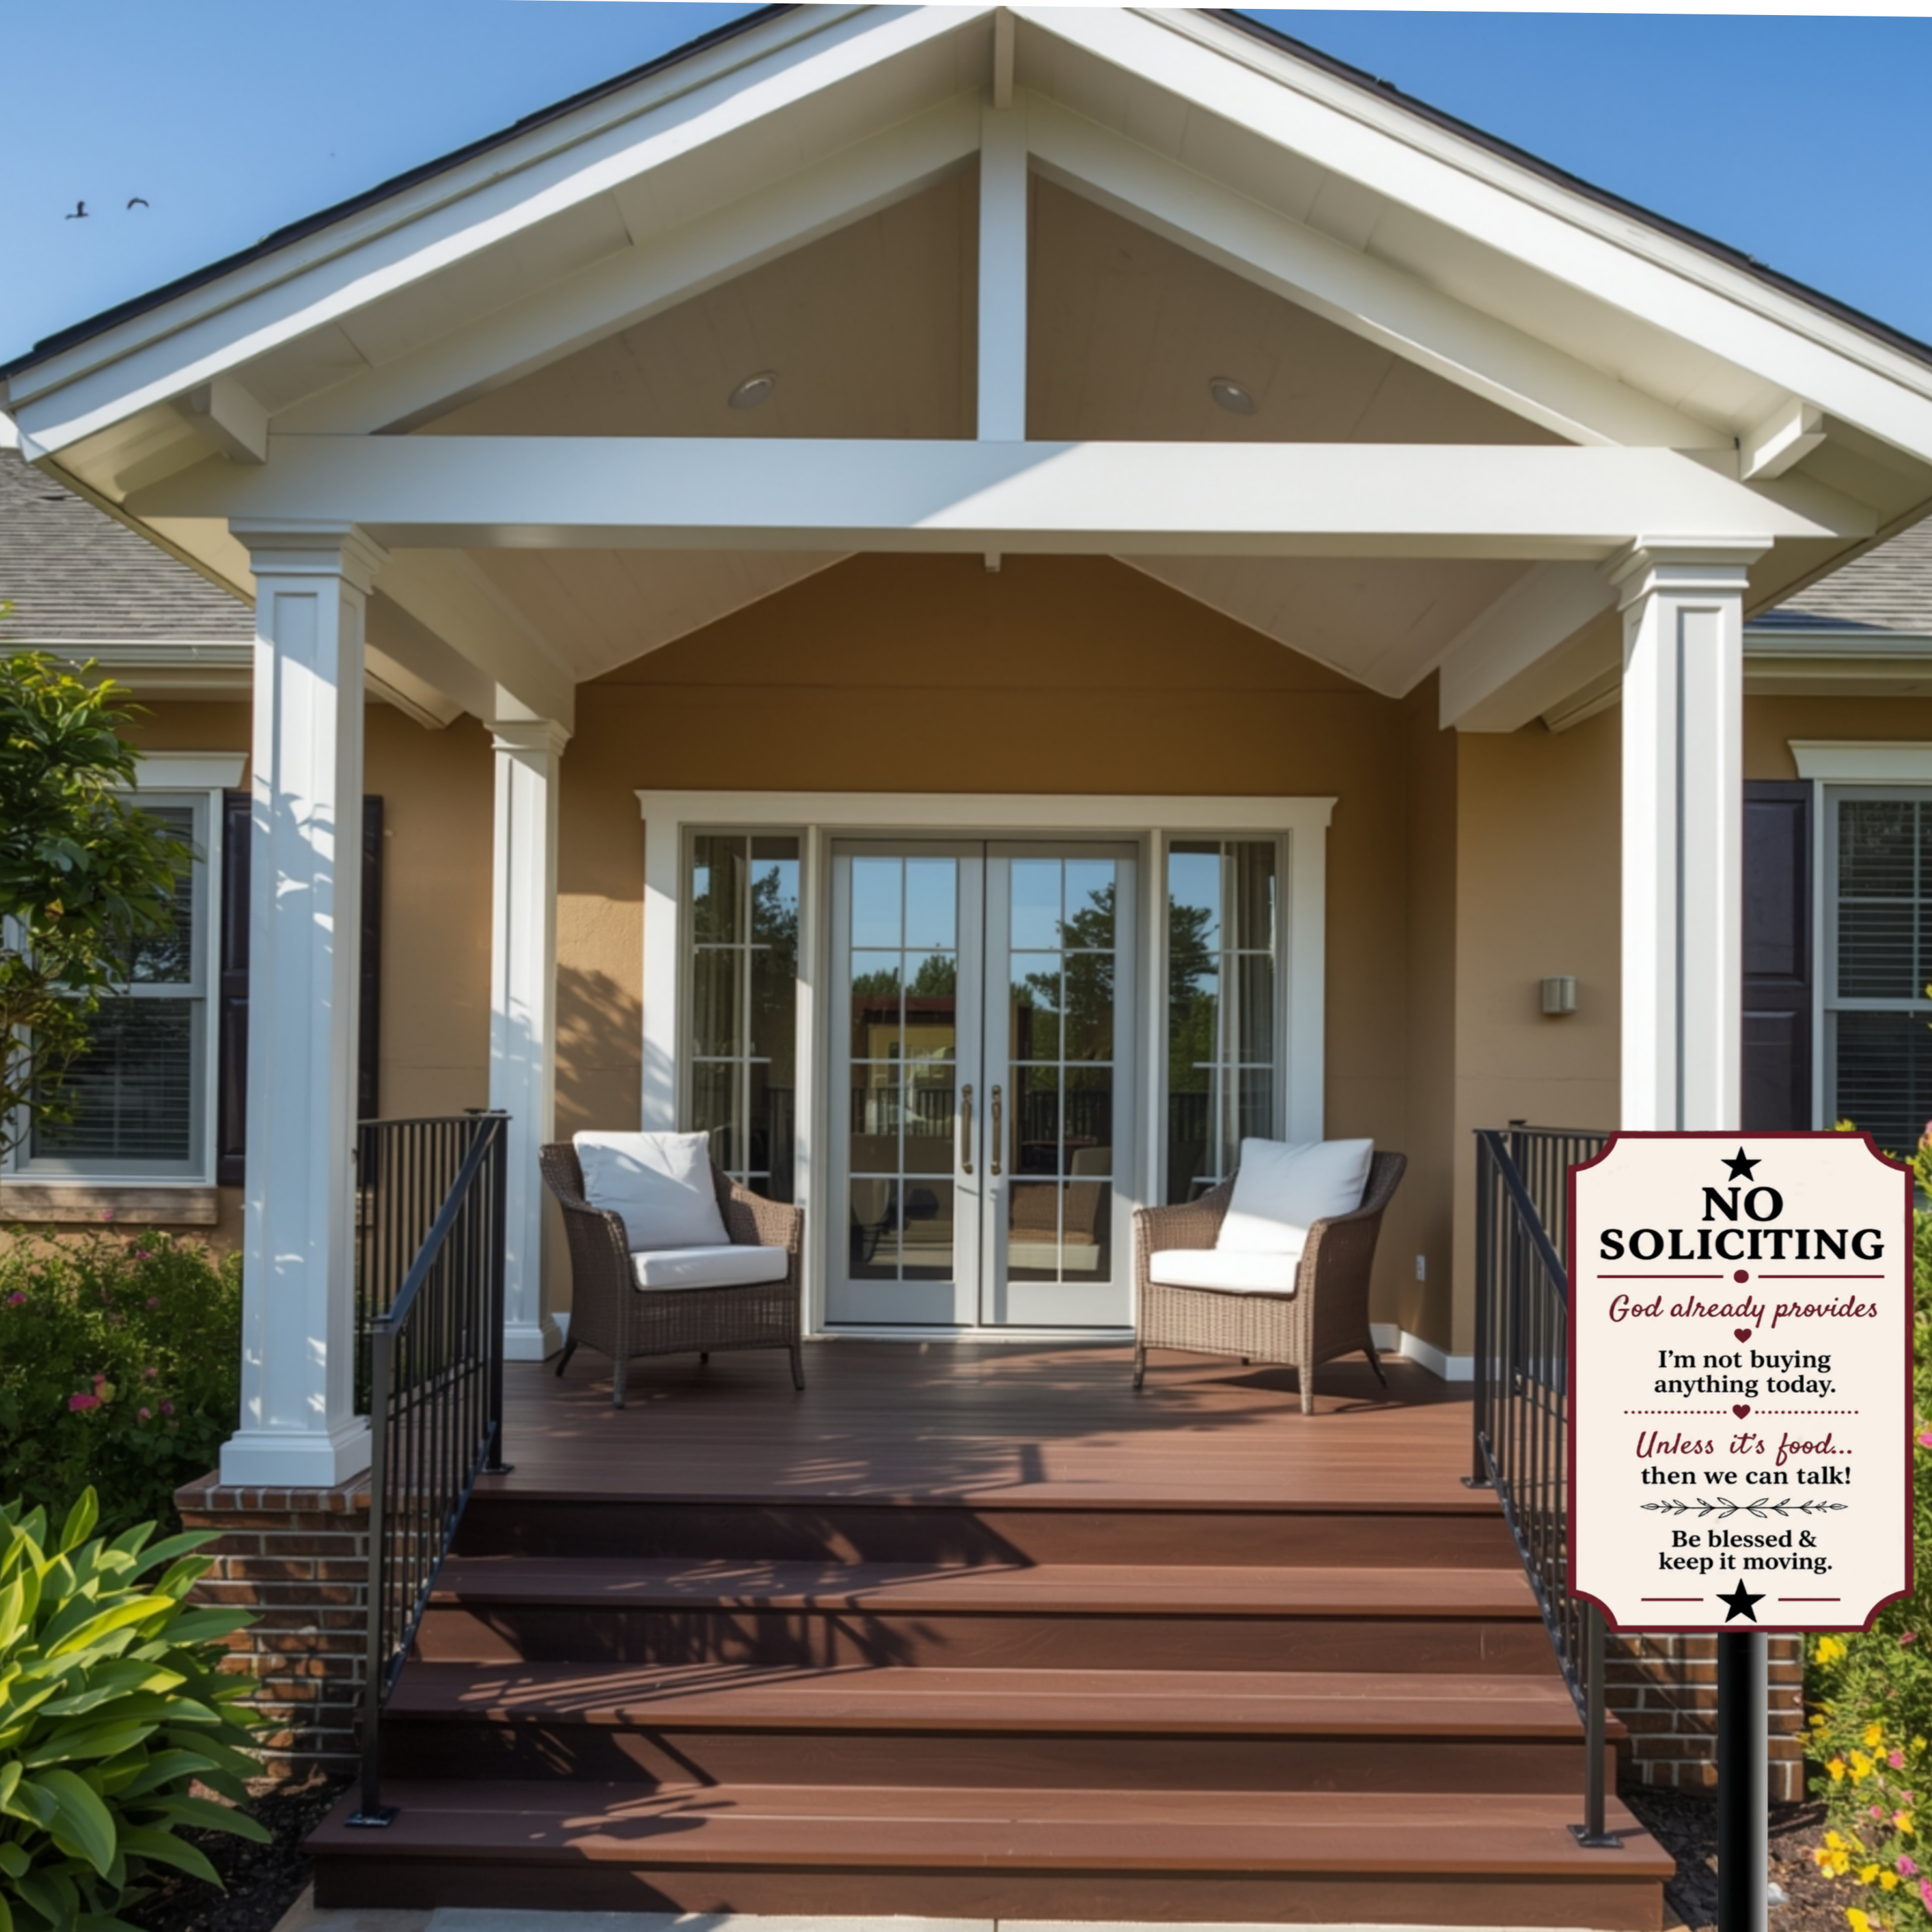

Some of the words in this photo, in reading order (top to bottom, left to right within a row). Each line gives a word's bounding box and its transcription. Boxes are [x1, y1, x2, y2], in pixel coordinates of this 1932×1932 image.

[1702, 1187, 1783, 1222] NO
[1601, 1228, 1884, 1260] SOLICITING
[1610, 1295, 1664, 1322] God
[1670, 1295, 1765, 1328] already
[1771, 1295, 1877, 1329] provides
[1659, 1350, 1696, 1368] I'm
[1703, 1352, 1742, 1368] not
[1750, 1350, 1831, 1373] buying
[1655, 1375, 1758, 1398] anything
[1767, 1375, 1836, 1398] today.
[1636, 1431, 1713, 1458] Unless
[1730, 1433, 1765, 1454] it's
[1776, 1433, 1852, 1466] food...
[1641, 1466, 1696, 1485] then
[1704, 1472, 1737, 1485] we
[1745, 1472, 1789, 1485] can
[1797, 1466, 1850, 1485] talk!
[1672, 1530, 1700, 1547] Be
[1708, 1530, 1792, 1547] blessed
[1799, 1530, 1817, 1547] &
[1659, 1552, 1713, 1574] keep
[1720, 1552, 1736, 1569] it
[1743, 1552, 1832, 1575] moving.
